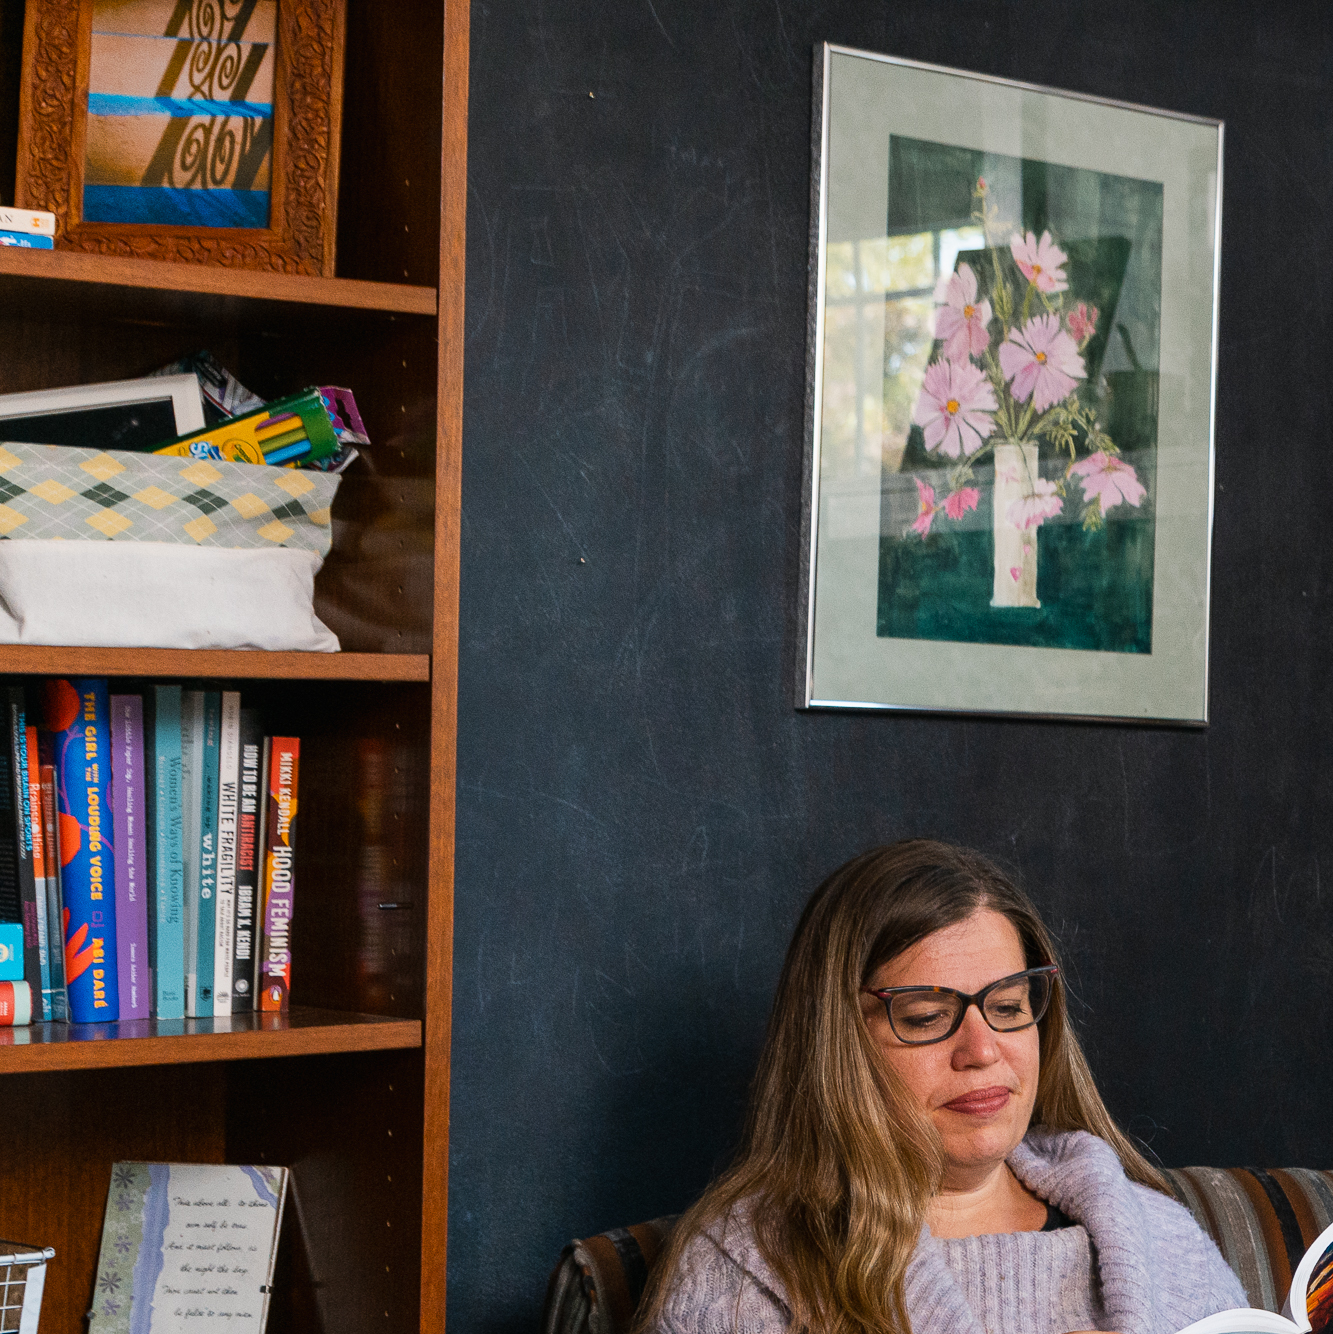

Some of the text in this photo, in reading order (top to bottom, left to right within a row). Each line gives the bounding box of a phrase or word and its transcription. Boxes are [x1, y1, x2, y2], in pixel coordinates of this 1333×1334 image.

[84, 692, 108, 1009] THE GIRL LOUDING VOICE ABI DARÉ
[166, 756, 182, 924] Women's Ways of Knowing
[201, 832, 216, 900] white
[219, 782, 237, 896] WHITE FRAGILITY
[238, 744, 259, 871] HOW TO BE AN ANTIRACIST
[269, 752, 294, 977] MIKKI KENDALL HOOD FEMINISM
